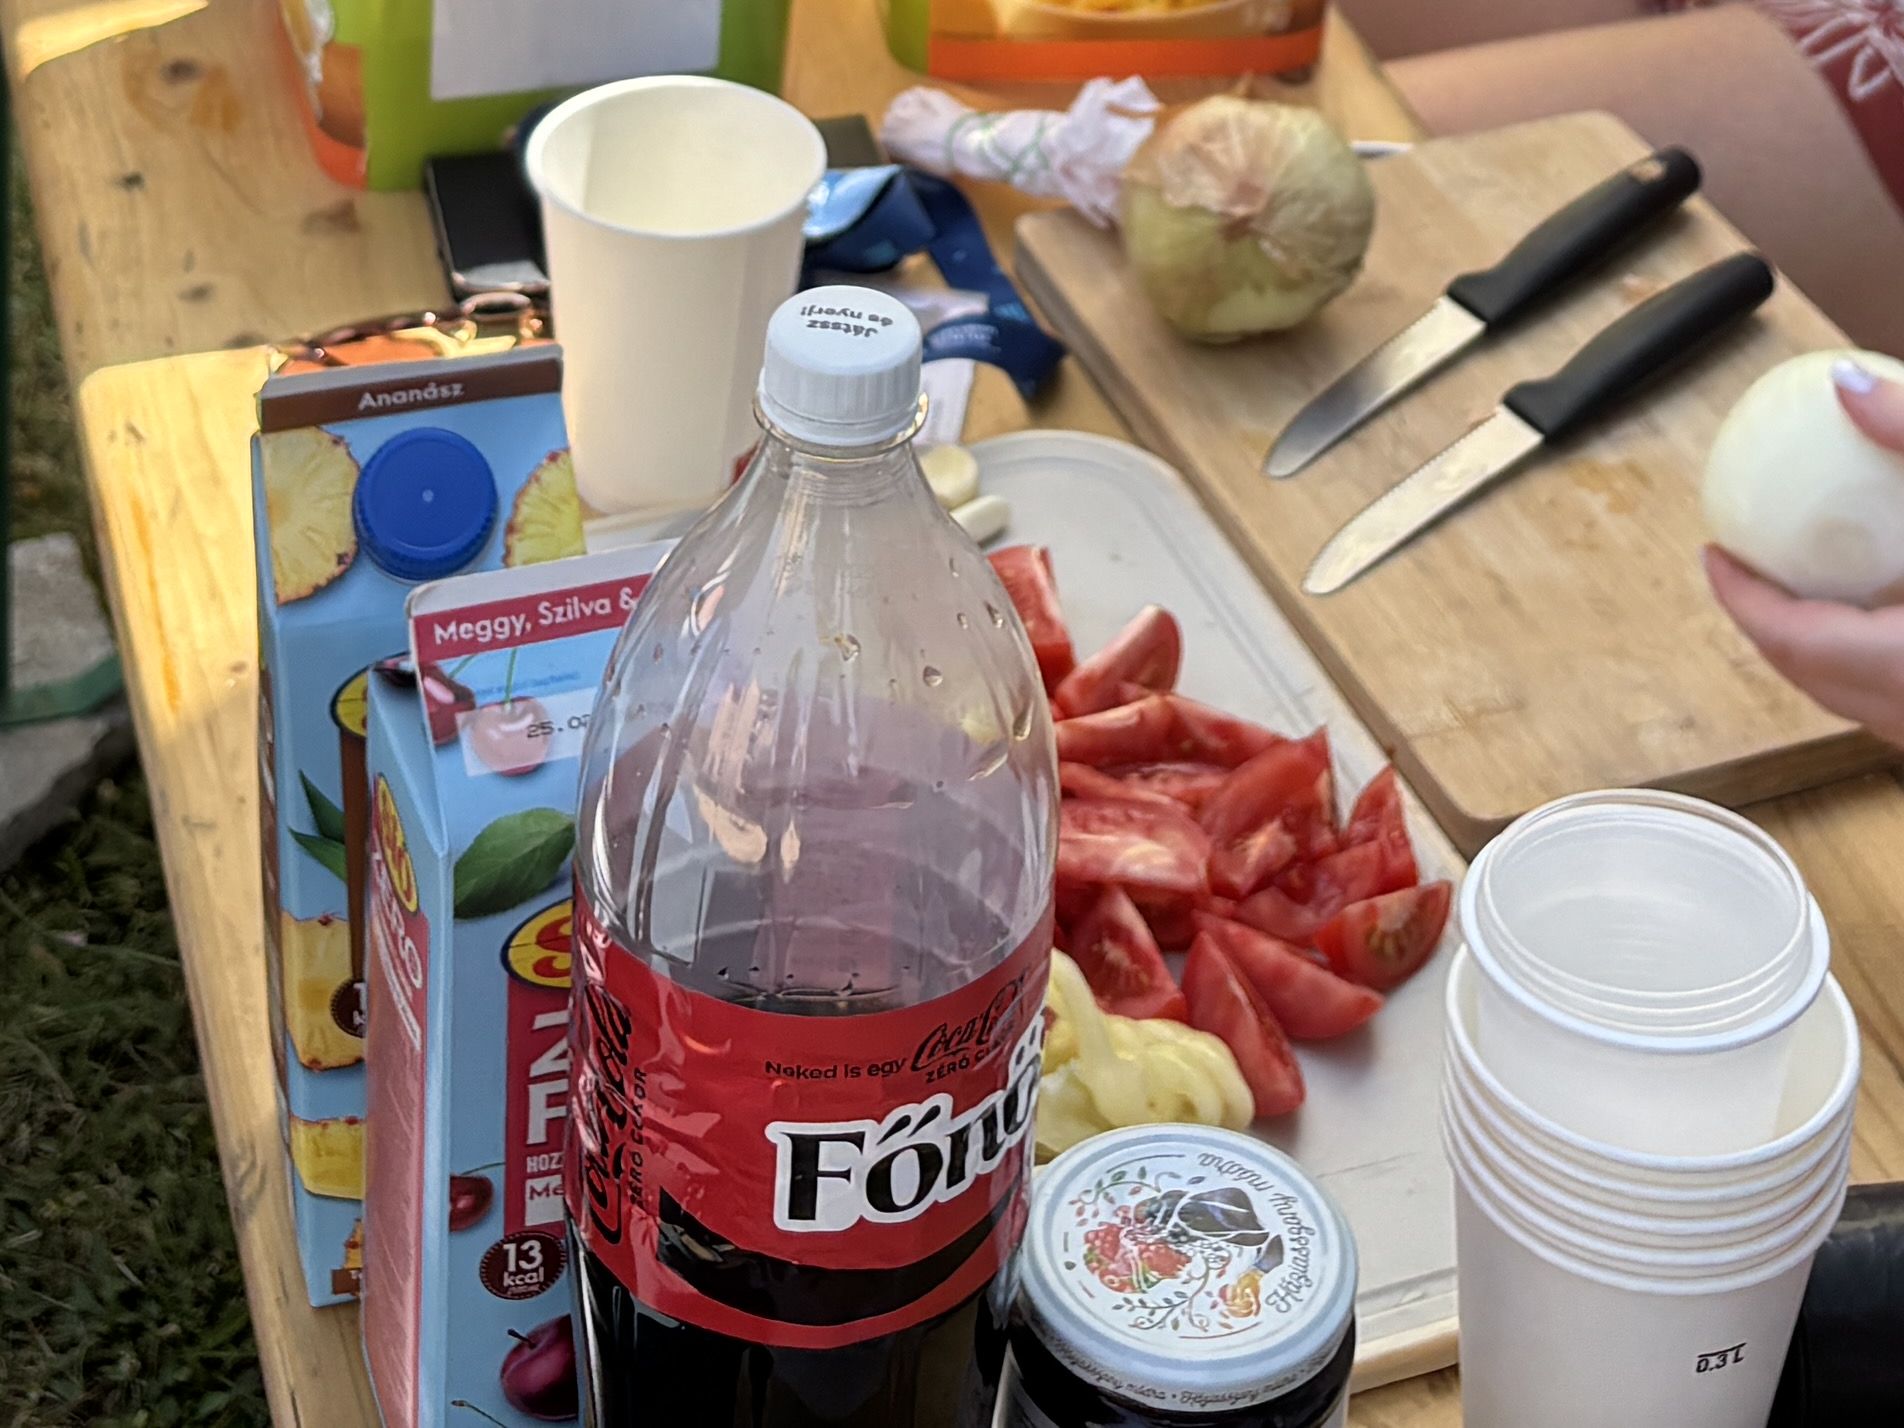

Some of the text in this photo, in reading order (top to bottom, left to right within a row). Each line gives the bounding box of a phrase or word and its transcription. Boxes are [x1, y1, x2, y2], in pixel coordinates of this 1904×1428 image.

[800, 304, 863, 320] nyerj!
[805, 318, 880, 338] Játssz
[358, 382, 465, 411] Ananász
[433, 610, 532, 646] Meggy,
[537, 594, 613, 627] Szilva
[764, 1060, 838, 1080] Neked
[844, 1062, 862, 1079] is
[866, 1057, 907, 1080] egy
[778, 1018, 1044, 1222] Főnö
[526, 1152, 565, 1174] HOZ
[502, 1239, 544, 1274] 13
[502, 1266, 545, 1288] kcal
[1696, 1352, 1728, 1374] 0.3
